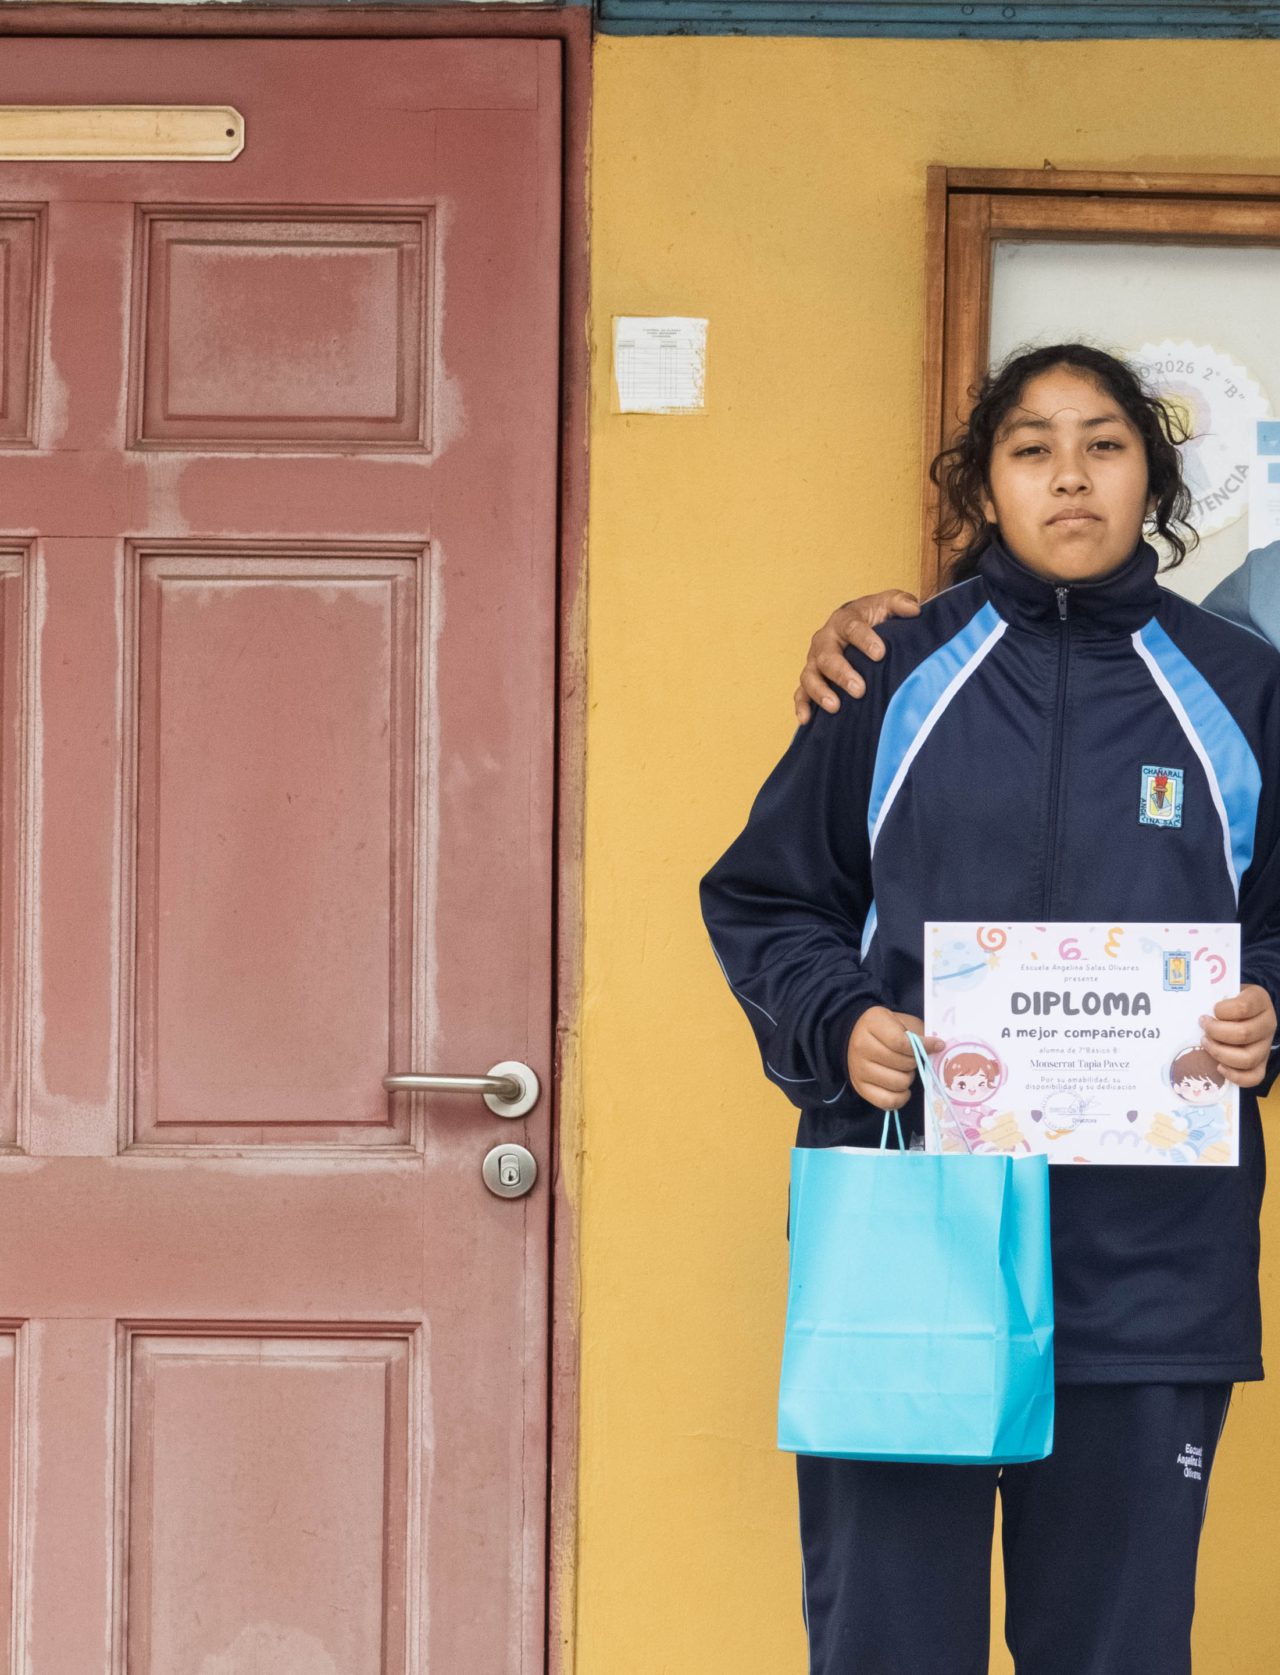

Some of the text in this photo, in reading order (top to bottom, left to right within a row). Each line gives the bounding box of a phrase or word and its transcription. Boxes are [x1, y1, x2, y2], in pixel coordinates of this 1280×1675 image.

[1155, 360, 1195, 375] 2026
[1052, 964, 1083, 972] Angelina
[1010, 991, 1151, 1016] DIPLOMA
[1001, 1026, 1161, 1040] A mejor compañero(a)
[1030, 1059, 1130, 1070] Monserrat Tapia Pavez
